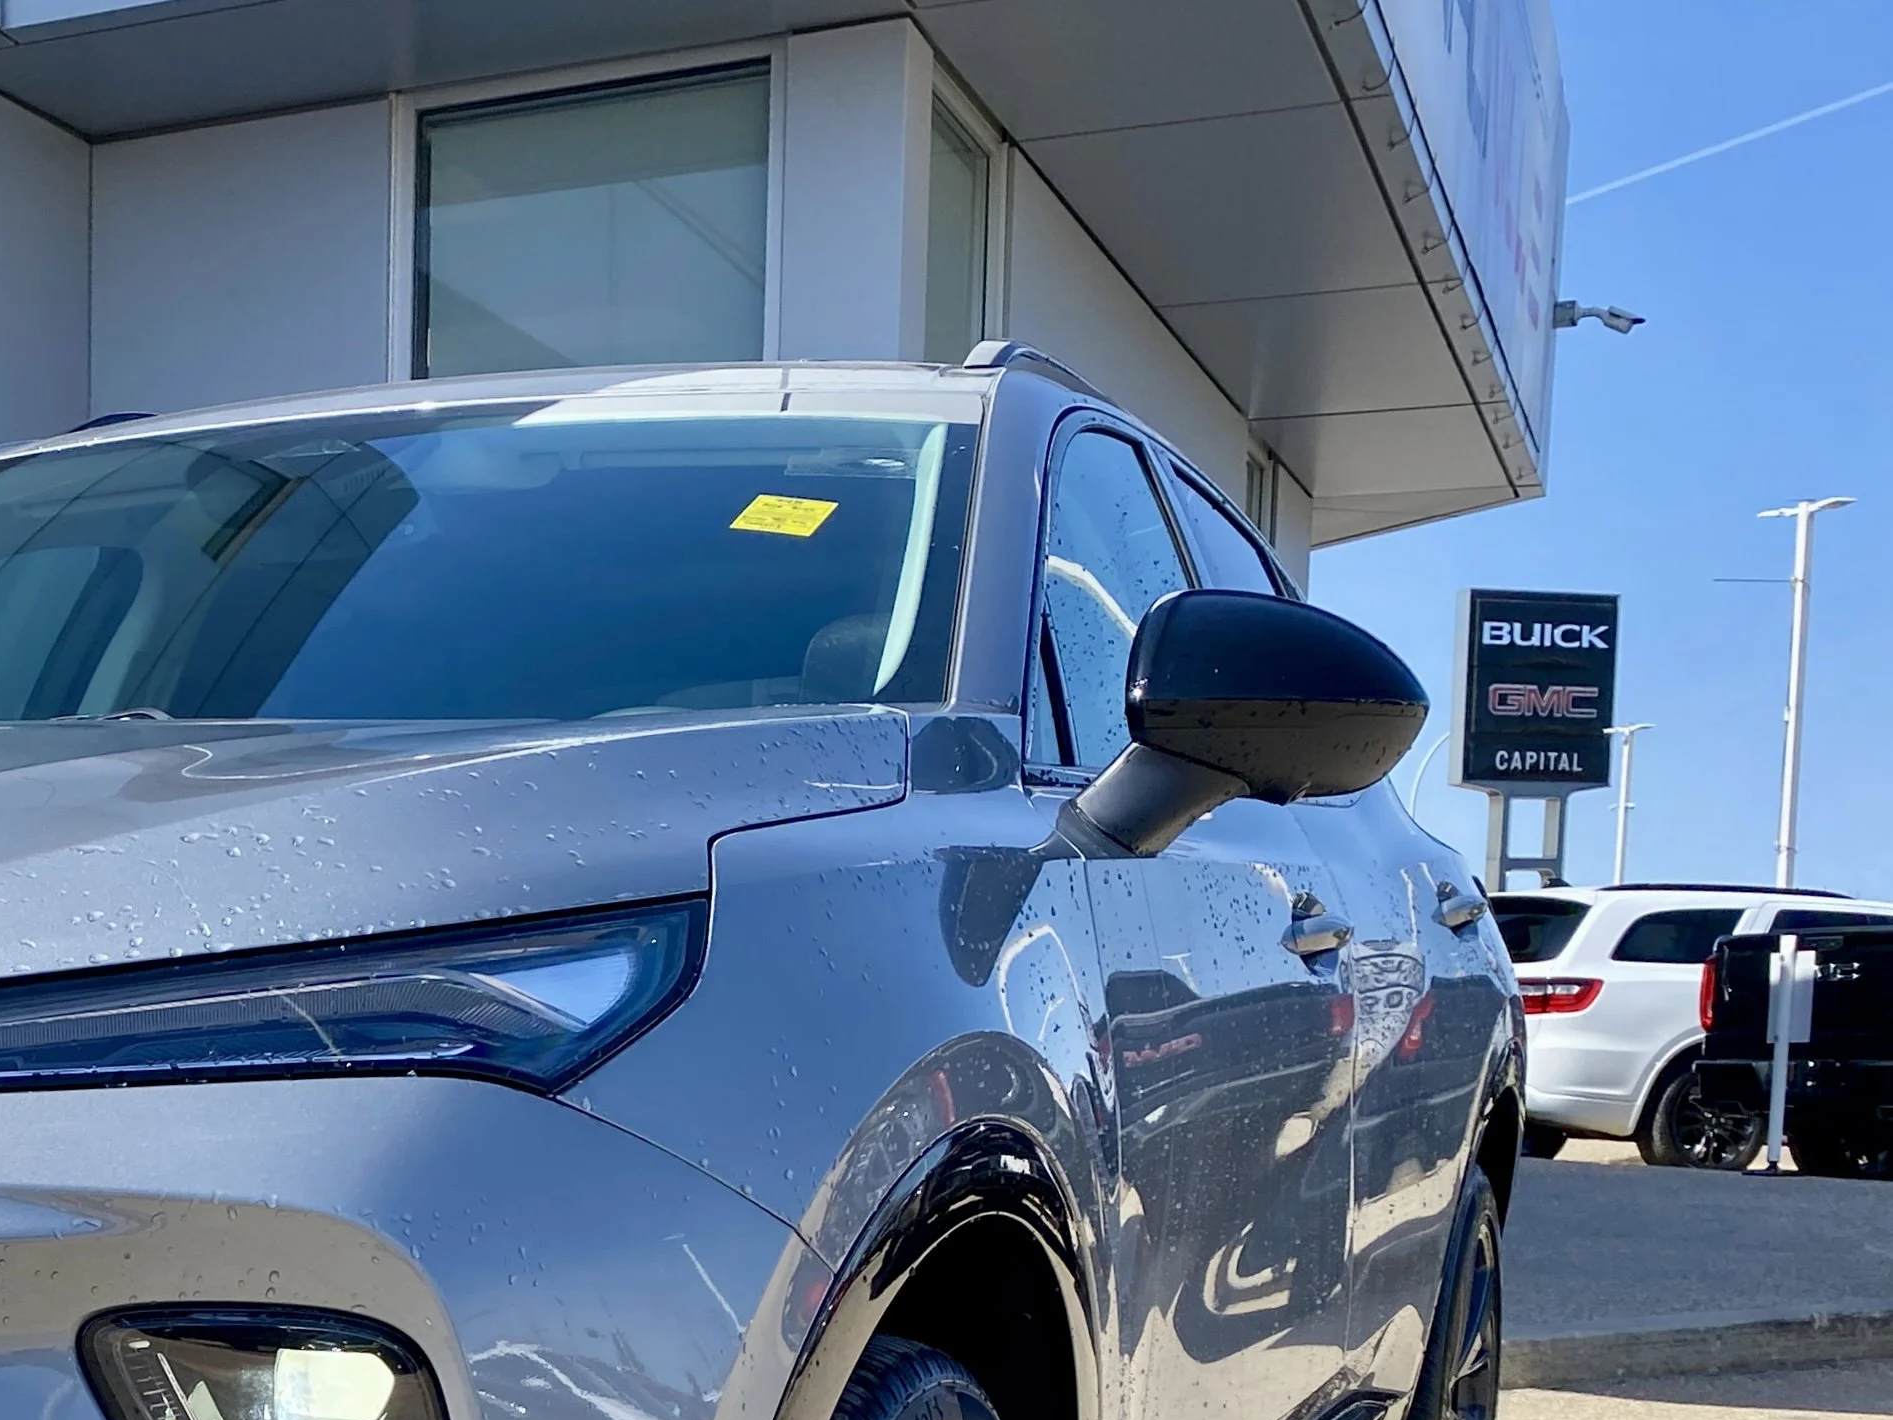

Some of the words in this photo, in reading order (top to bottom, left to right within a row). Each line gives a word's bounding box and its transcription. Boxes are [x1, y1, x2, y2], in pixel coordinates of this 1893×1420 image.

[1481, 620, 1609, 649] BUICK
[1488, 683, 1599, 719] GMC
[1494, 750, 1583, 772] CAPITAL
